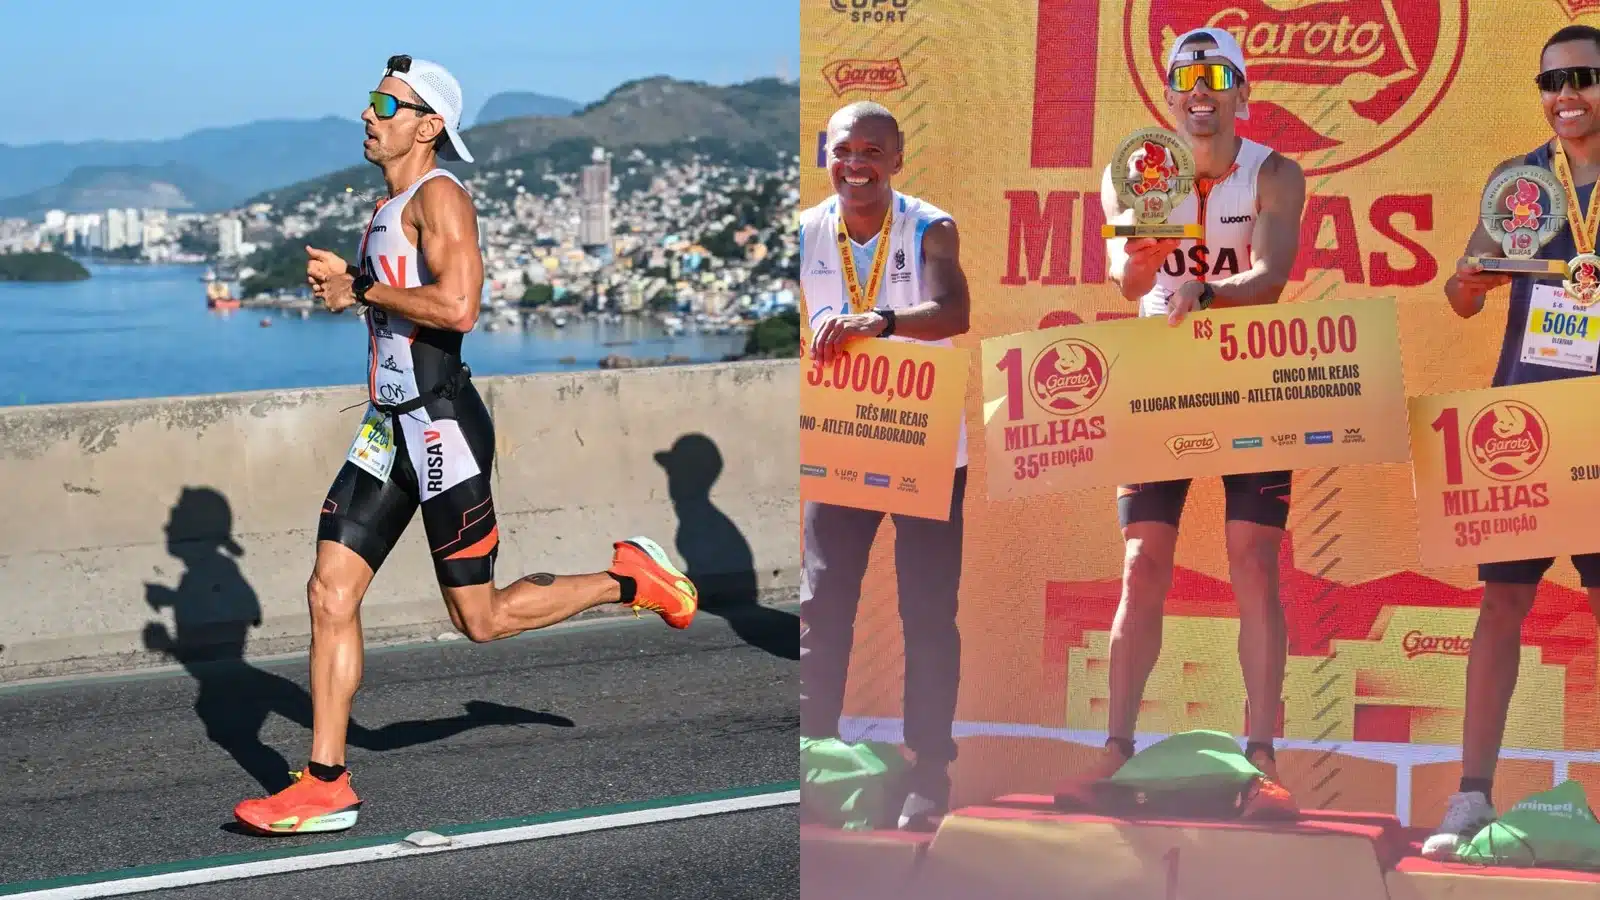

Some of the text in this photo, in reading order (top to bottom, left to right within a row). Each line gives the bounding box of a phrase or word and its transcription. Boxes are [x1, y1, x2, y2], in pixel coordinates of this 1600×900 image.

[851, 11, 907, 23] SPORT
[835, 63, 898, 84] Garoto
[1000, 190, 1440, 288] MIAS
[1542, 311, 1588, 338] 5064
[1193, 314, 1358, 362] R$ 5.000,00
[807, 350, 936, 402] 3.000,00
[1046, 374, 1092, 392] Garoto
[1272, 364, 1360, 384] CINCO MIL REAIS
[1129, 398, 1142, 414] 1º
[1143, 396, 1177, 413] LUGAR
[1178, 389, 1241, 410] MASCULINO
[1247, 386, 1284, 404] ATLETA
[1285, 382, 1362, 401] COLABORADOR
[855, 403, 929, 429] TRÊS MIL REAIS
[822, 417, 855, 437] ATLETA
[855, 422, 928, 447] COLABORADOR
[1004, 415, 1107, 452] MILHAS
[1173, 436, 1216, 453] Garoto
[1271, 433, 1297, 444] LUPO
[1485, 438, 1531, 454] Garoto
[834, 468, 858, 478] LUPO
[1013, 444, 1095, 481] 35ª EDIÇÃO
[1570, 464, 1600, 481] 3º LU
[1441, 482, 1550, 517] MILHAS
[1454, 513, 1538, 547] 35ª EDIÇÃO
[1402, 630, 1473, 655] Garoto
